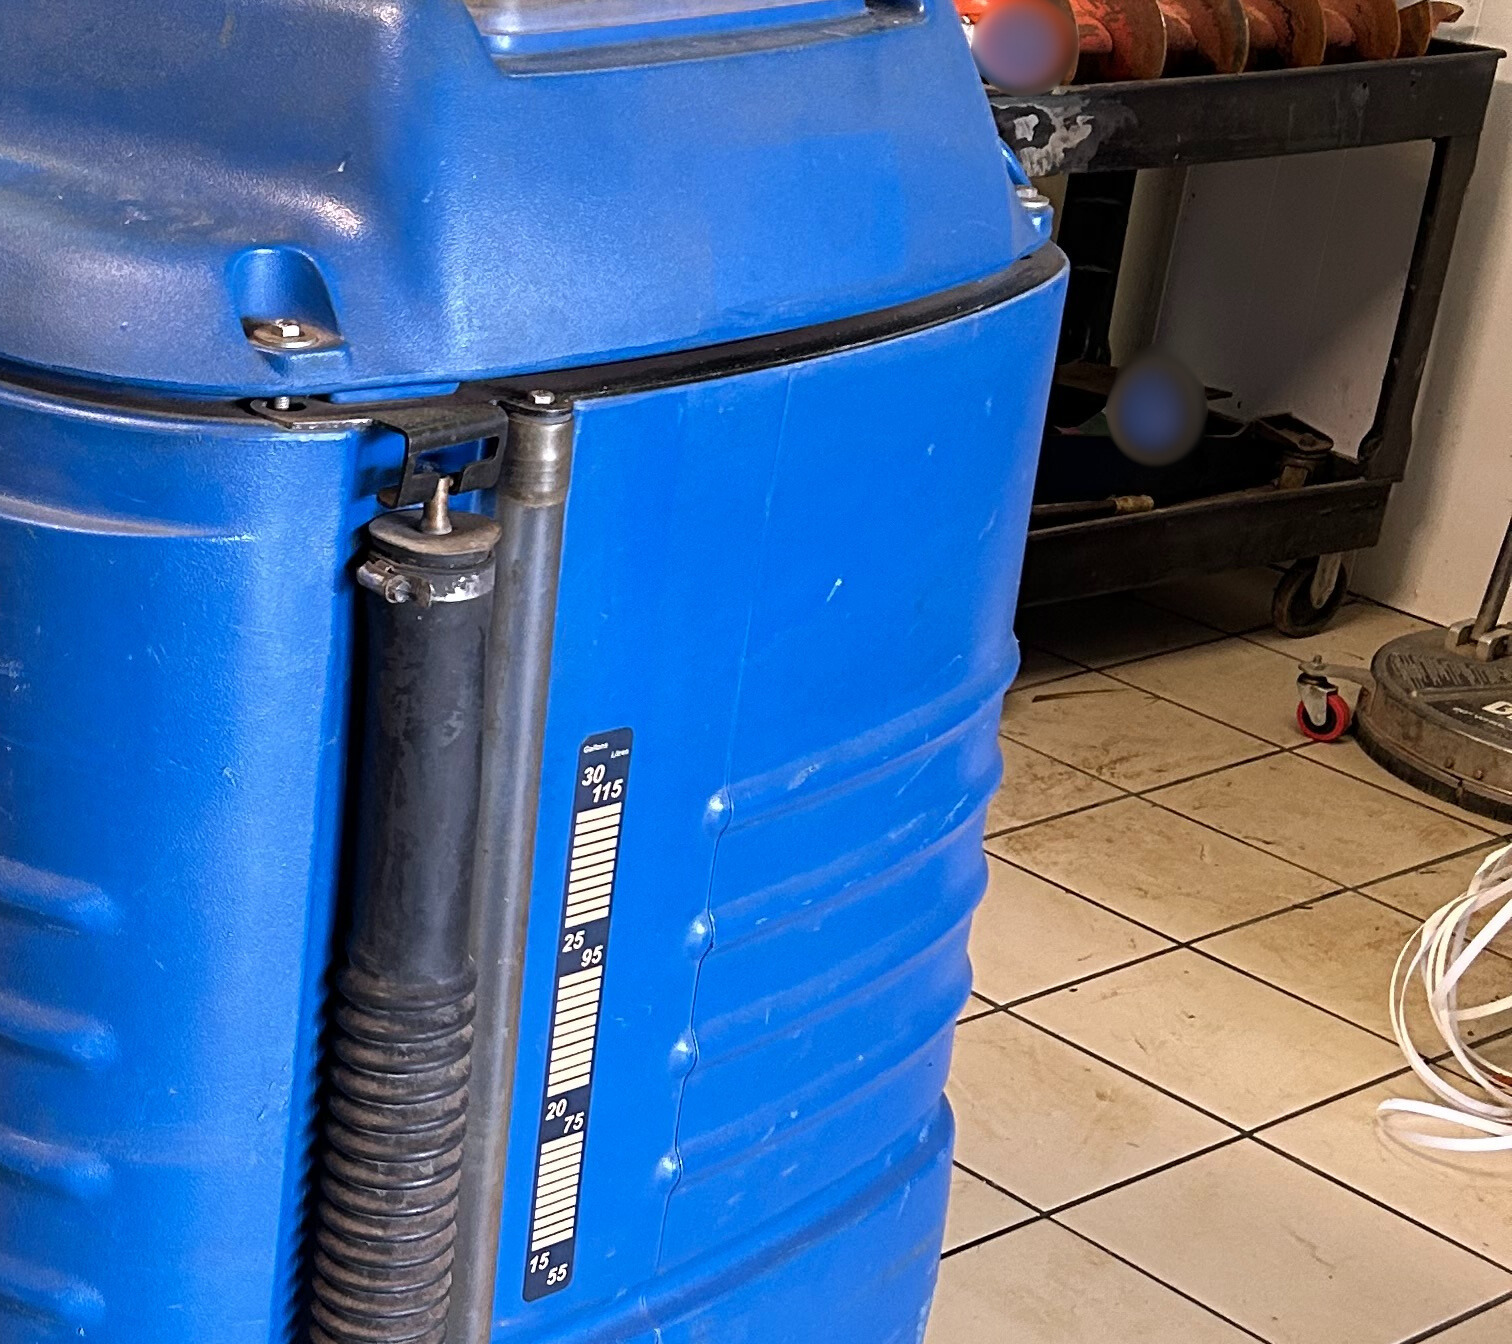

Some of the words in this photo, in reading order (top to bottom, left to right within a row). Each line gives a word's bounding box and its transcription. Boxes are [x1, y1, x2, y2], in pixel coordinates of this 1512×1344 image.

[581, 763, 606, 787] 30
[592, 778, 624, 803] 115
[561, 929, 586, 953] 25
[580, 944, 604, 968] 95
[545, 1097, 568, 1121] 20
[563, 1112, 585, 1134] 75
[529, 1251, 550, 1274] 15
[546, 1263, 568, 1286] 55
